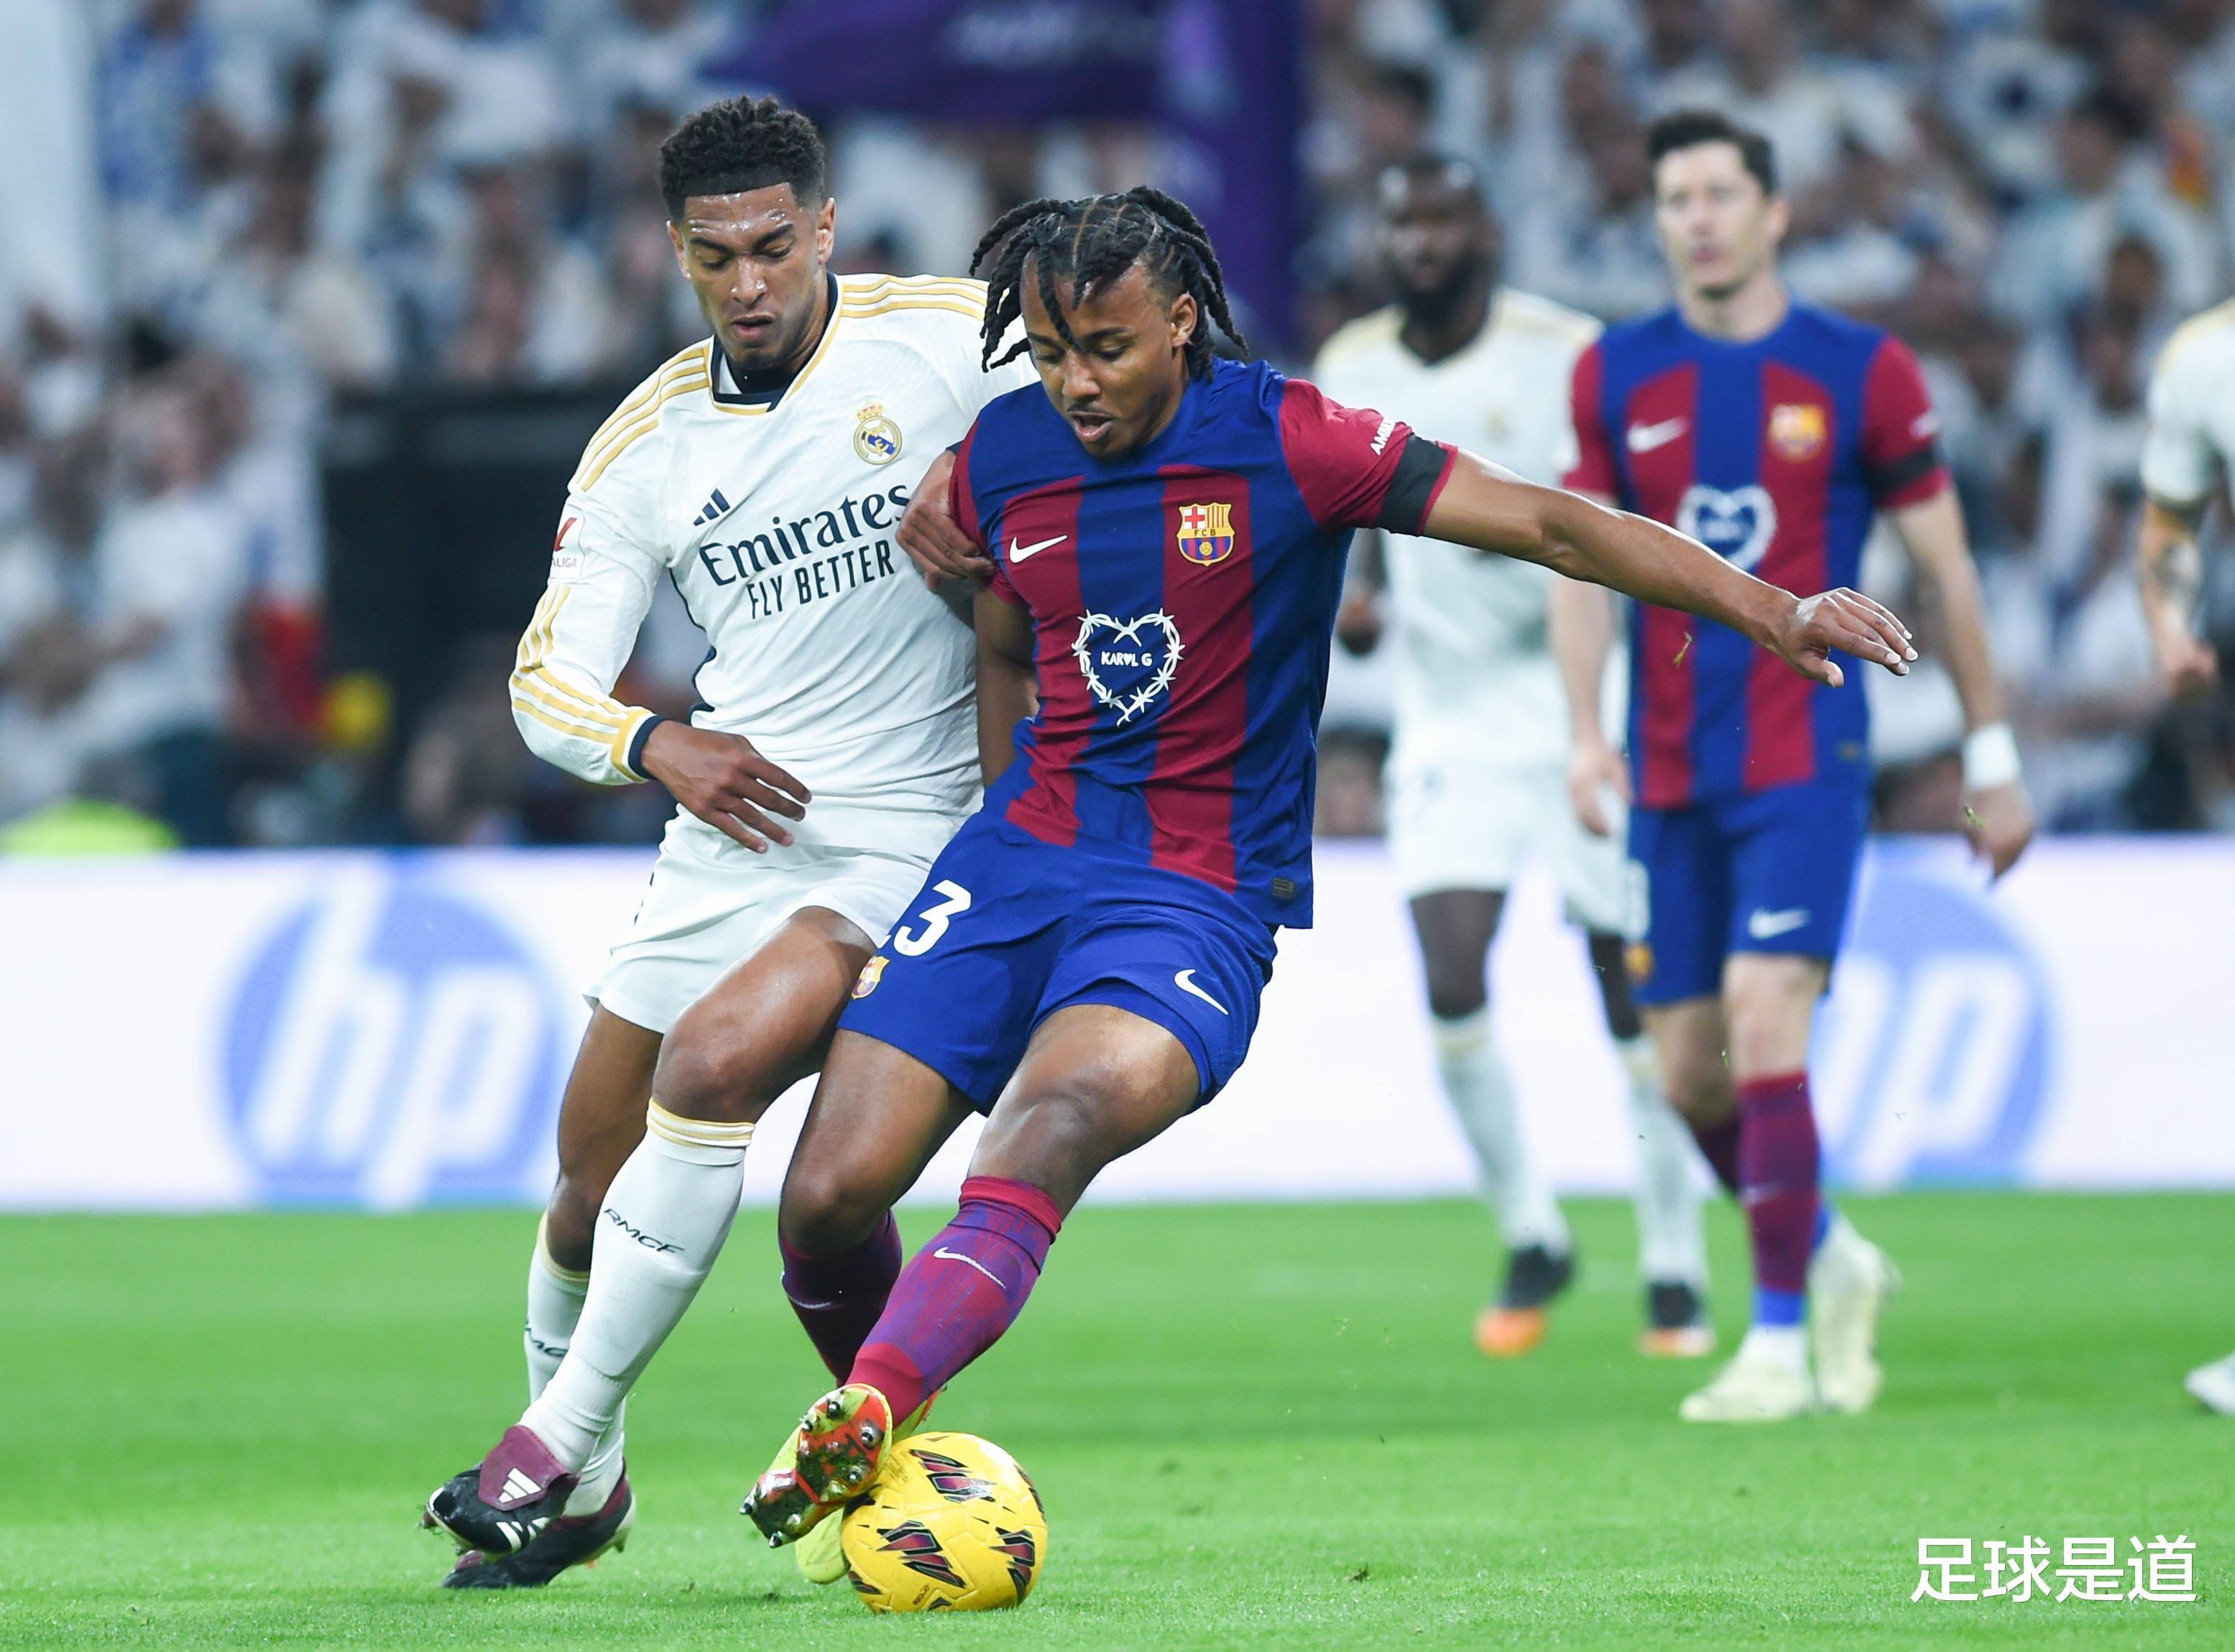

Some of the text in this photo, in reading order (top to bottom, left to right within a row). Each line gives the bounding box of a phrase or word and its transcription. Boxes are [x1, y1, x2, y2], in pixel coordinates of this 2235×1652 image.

[699, 485, 911, 586] Emirates
[746, 539, 895, 619] FLY BETTER
[1141, 652, 1153, 667] G
[248, 859, 539, 1209] hp
[604, 1208, 686, 1252] RMCF
